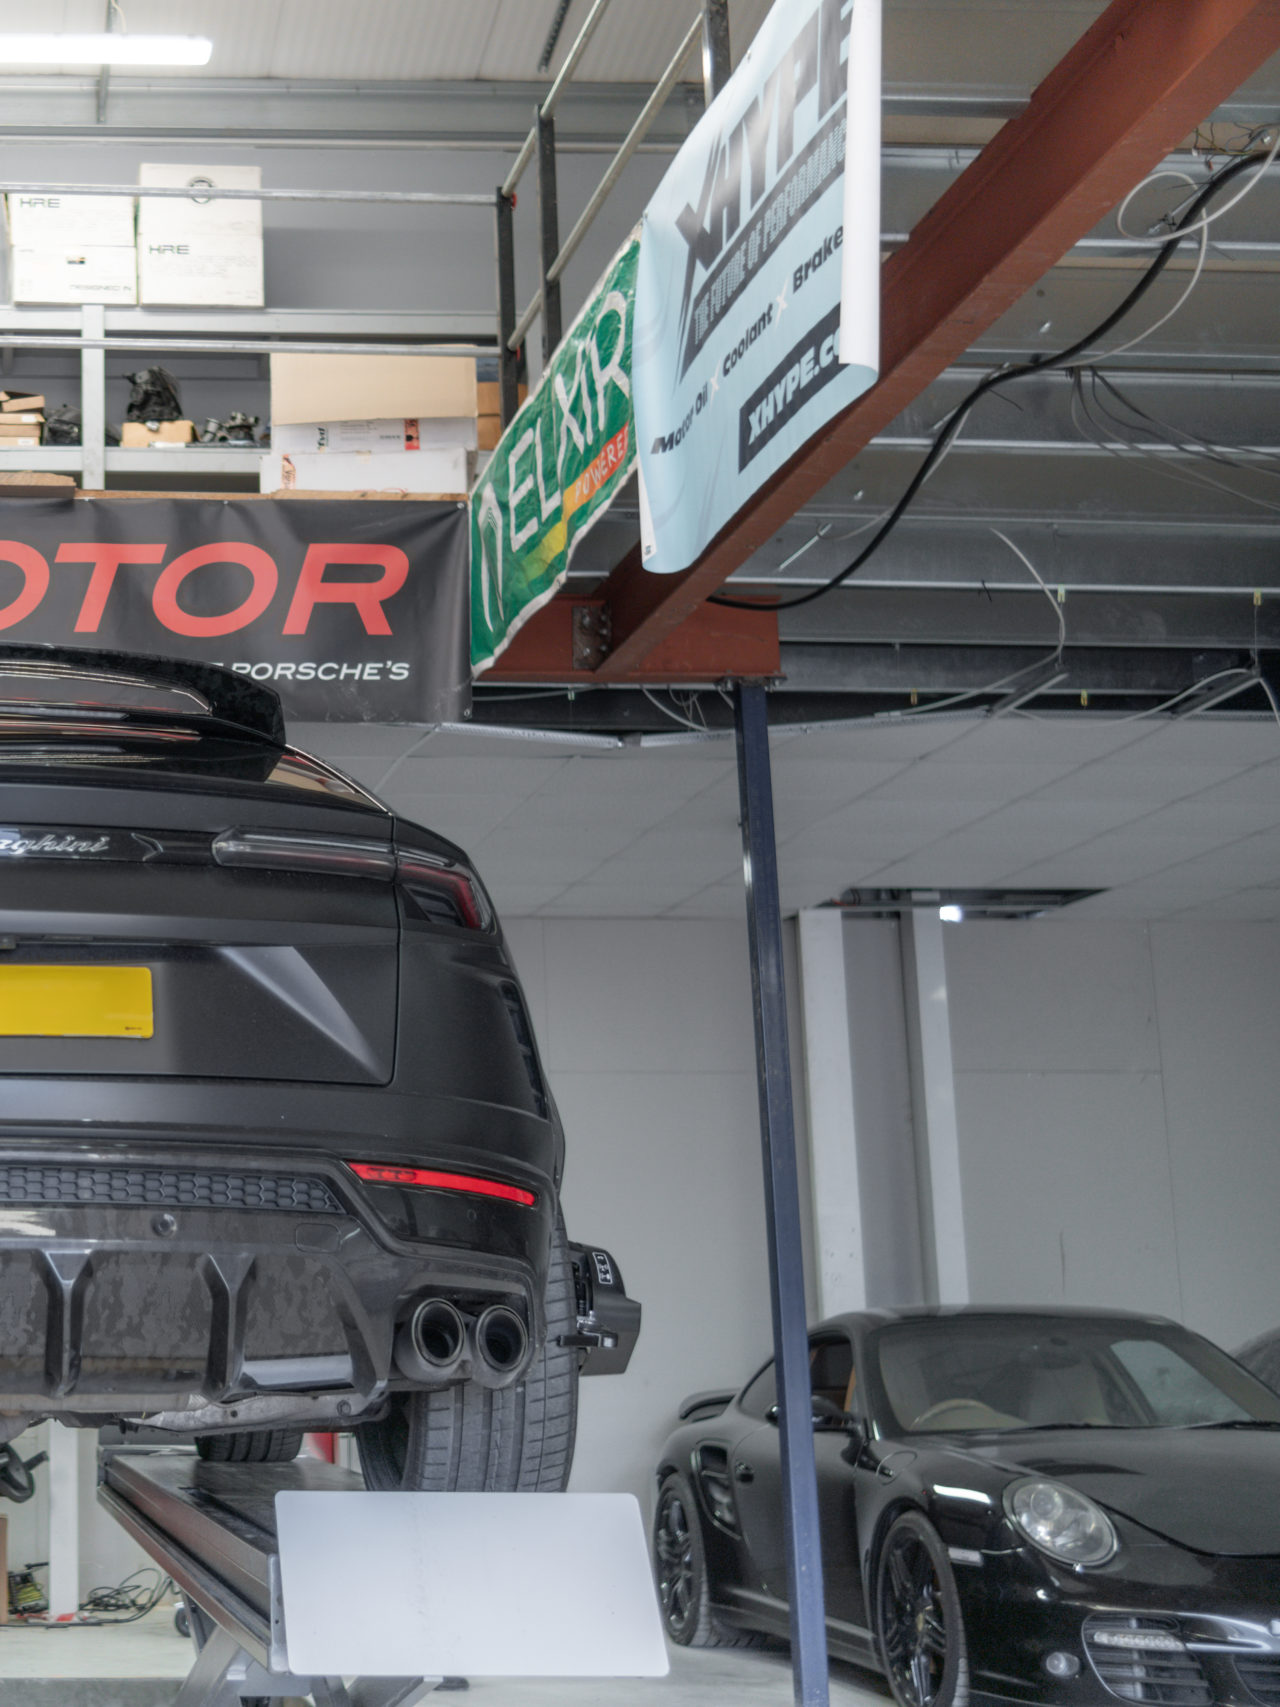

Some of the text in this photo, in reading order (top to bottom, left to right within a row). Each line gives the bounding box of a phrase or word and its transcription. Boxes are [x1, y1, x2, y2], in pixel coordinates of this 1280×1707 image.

[19, 197, 61, 209] HRE
[148, 244, 191, 255] HRE
[747, 219, 763, 271] OF
[650, 403, 695, 455] Motor
[695, 381, 709, 416] Oil
[722, 302, 774, 378] Coolant
[793, 224, 843, 294] Brake
[231, 660, 411, 681] PORSCHE'S
